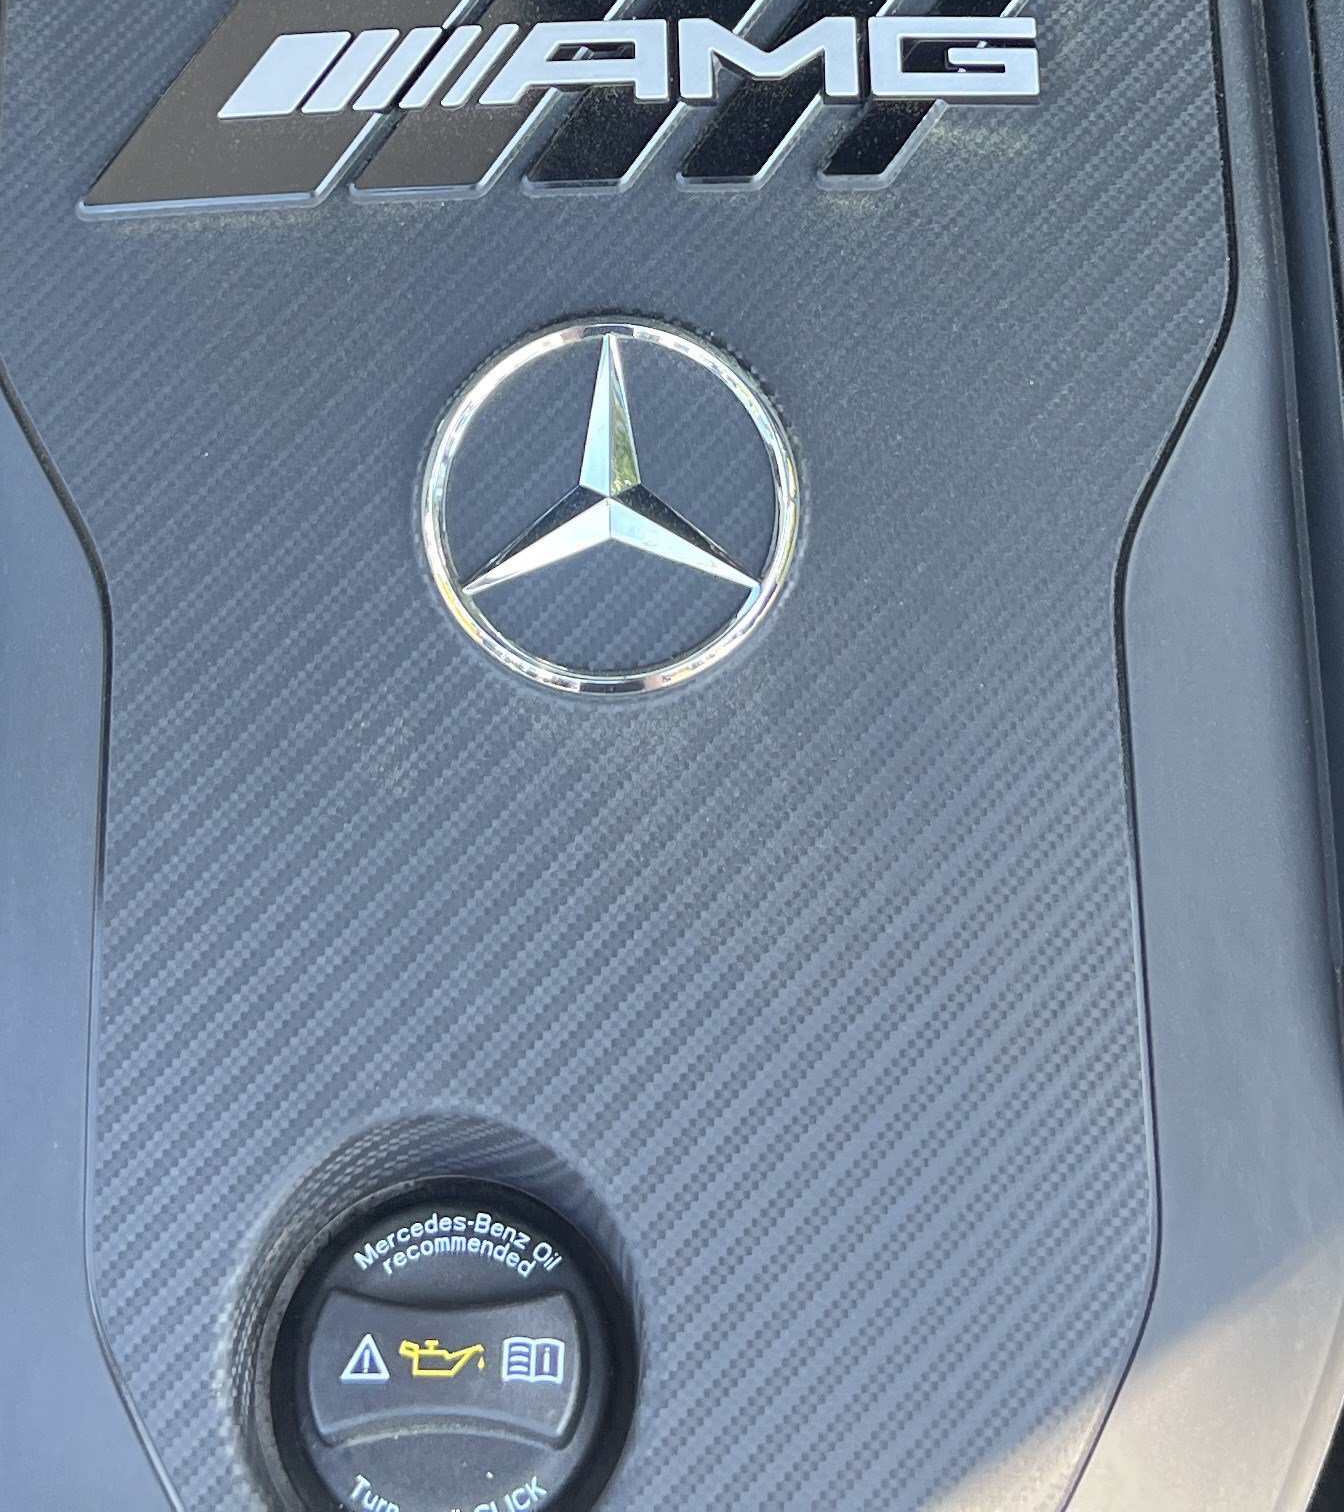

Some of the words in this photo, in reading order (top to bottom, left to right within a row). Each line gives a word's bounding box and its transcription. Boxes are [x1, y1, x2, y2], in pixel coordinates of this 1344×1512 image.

[478, 15, 1042, 105] AMG
[353, 1212, 531, 1270] Mercedes-Benz
[533, 1242, 562, 1271] Oil
[382, 1235, 537, 1277] recommended
